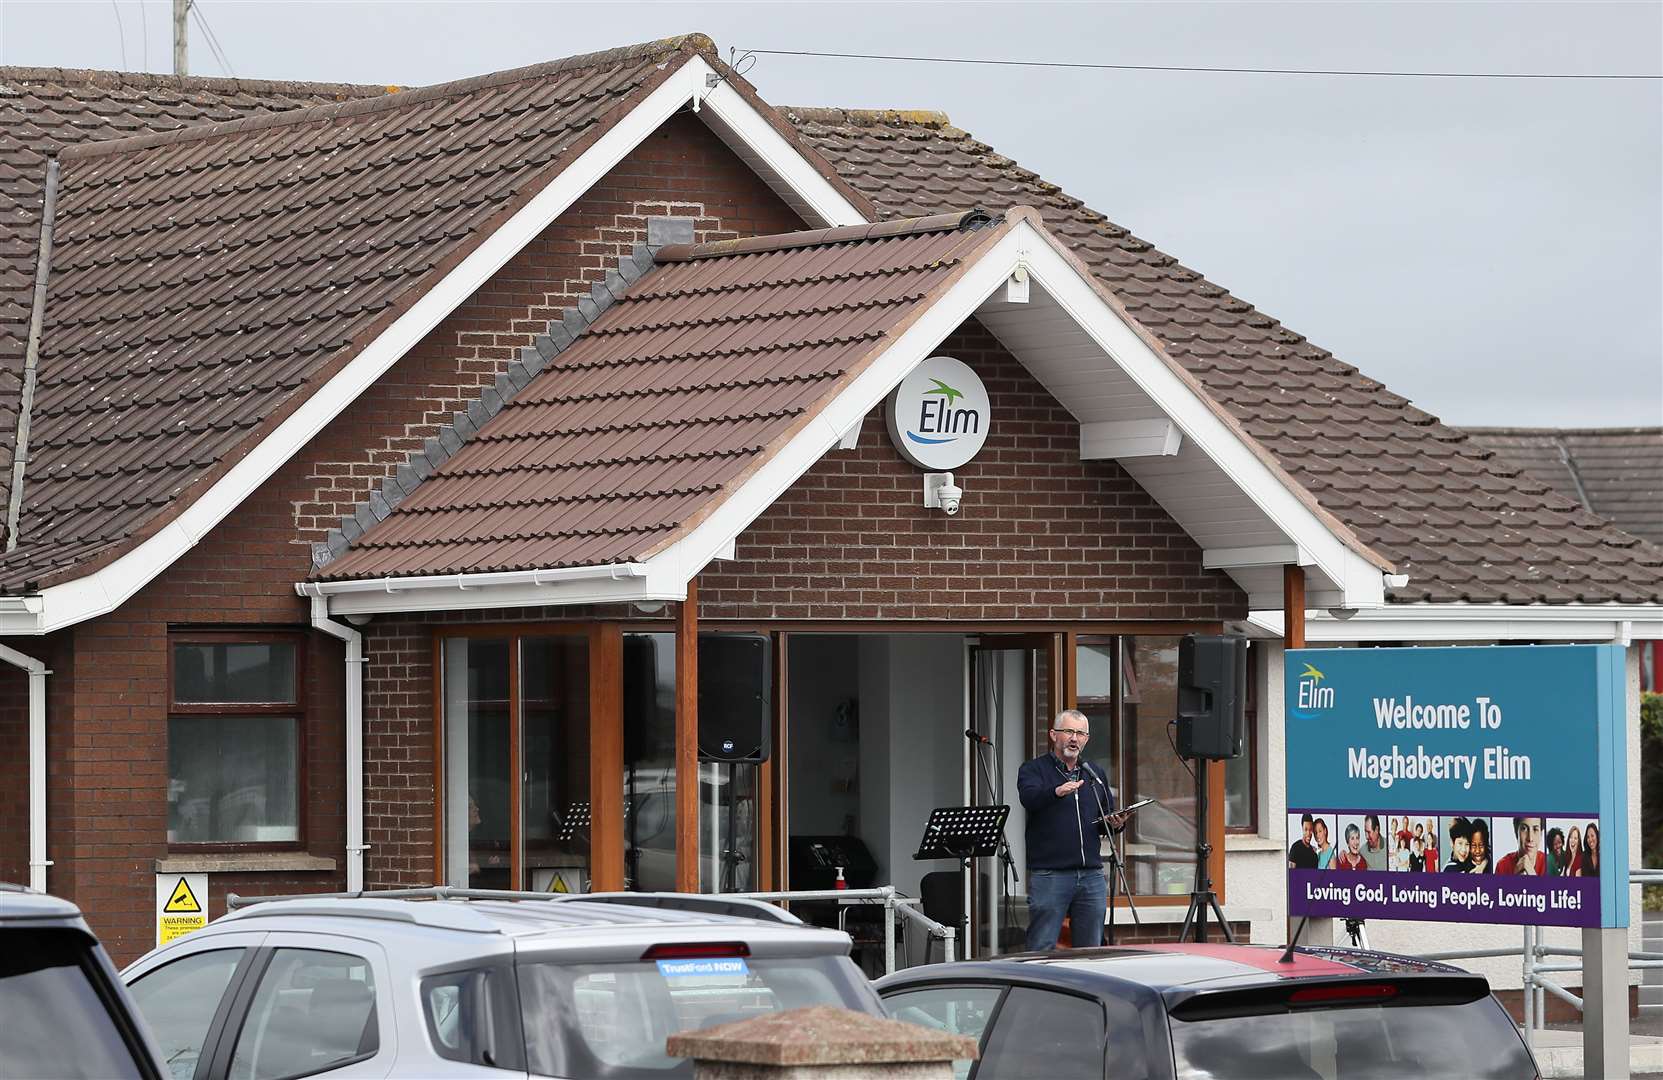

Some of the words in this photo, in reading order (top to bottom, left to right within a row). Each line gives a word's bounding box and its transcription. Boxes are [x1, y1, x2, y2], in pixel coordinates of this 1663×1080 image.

[919, 398, 979, 433] Elim
[1298, 680, 1334, 709] Elim
[1373, 696, 1470, 729] Welcome
[1476, 697, 1501, 729] To
[1348, 746, 1477, 789] Maghaberry
[1484, 746, 1531, 780] Elim
[1306, 882, 1351, 905] Loving
[1355, 883, 1388, 905] God,
[1392, 885, 1438, 909] Loving
[1442, 887, 1494, 910] People,
[1498, 889, 1546, 912] Loving
[1550, 890, 1582, 910] Life!
[662, 962, 712, 973] TrustFord
[715, 962, 742, 971] NOW
